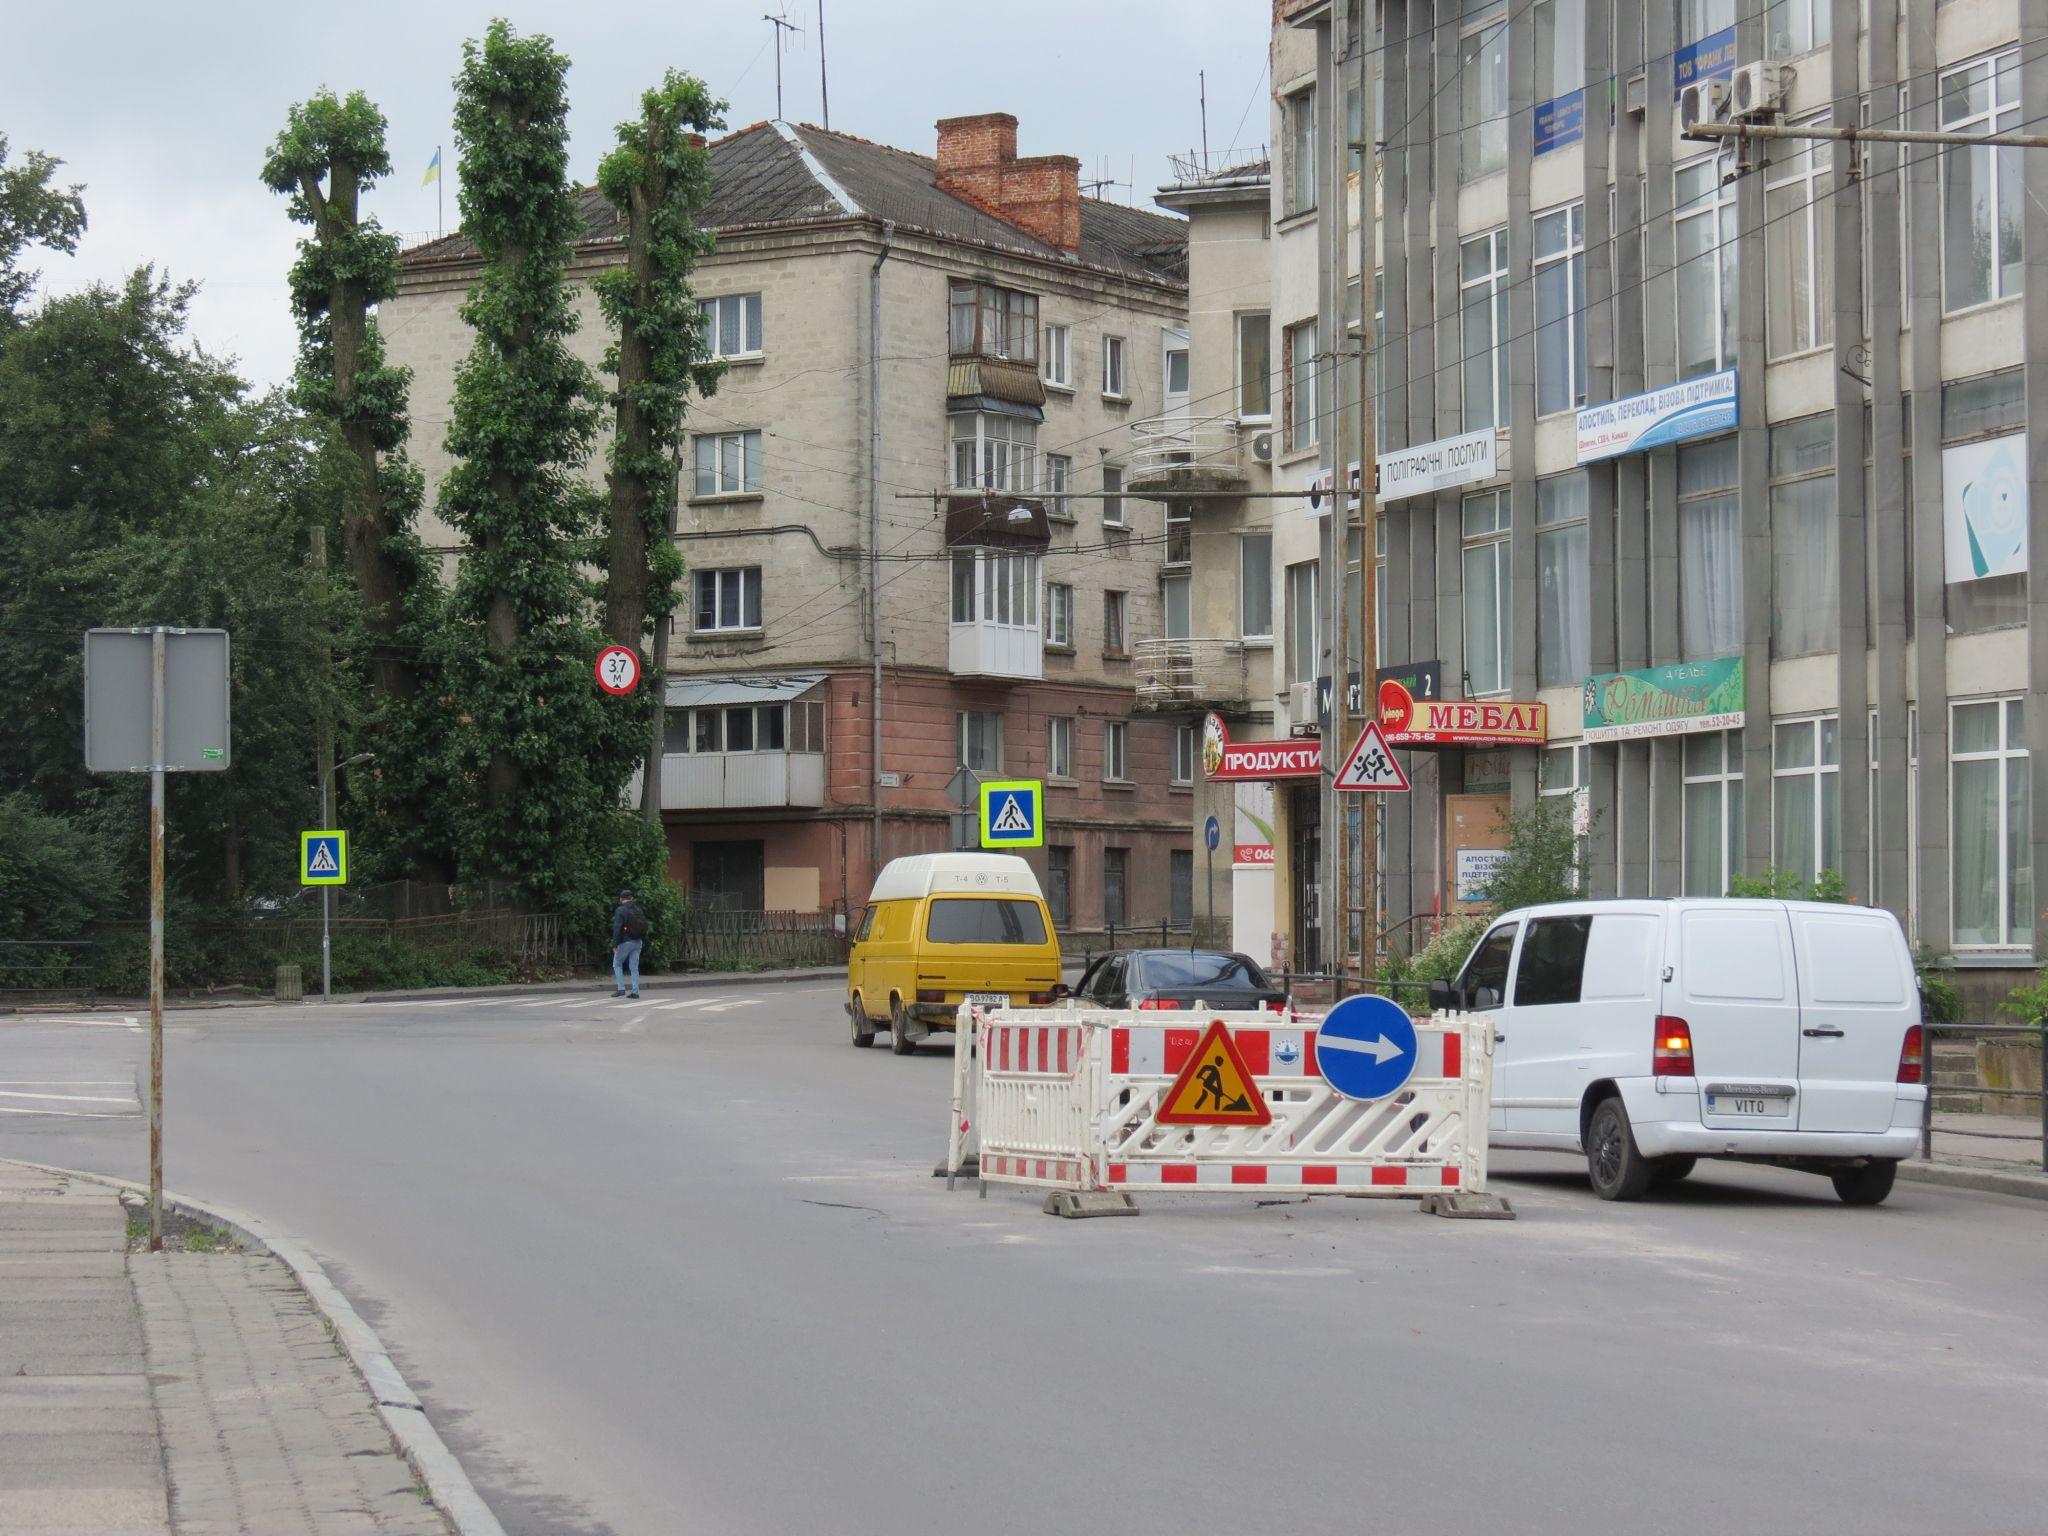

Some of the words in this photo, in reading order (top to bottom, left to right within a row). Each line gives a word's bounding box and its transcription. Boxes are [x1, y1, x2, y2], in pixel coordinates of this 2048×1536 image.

[1578, 411, 1617, 432] АПОСТИЛЬ,
[1618, 397, 1657, 421] ПЕРЕКЛАД,
[1658, 389, 1685, 410] ВІЗОВА
[1387, 452, 1443, 483] ПОЛІГРАФІЧНІ
[1448, 440, 1487, 468] ПОСЛУГИ
[1424, 673, 1432, 696] 2
[1601, 676, 1711, 721] Ромашка
[1428, 705, 1540, 732] МЕБЛІ
[1585, 727, 1618, 741] ПОШИТТЯ
[1621, 727, 1631, 737] ТА
[1633, 723, 1662, 736] РЕМОНТ
[1666, 720, 1689, 732] ОДЯГУ
[1225, 749, 1321, 771] ПРОДУКТИ
[1735, 1099, 1765, 1113] VITO
